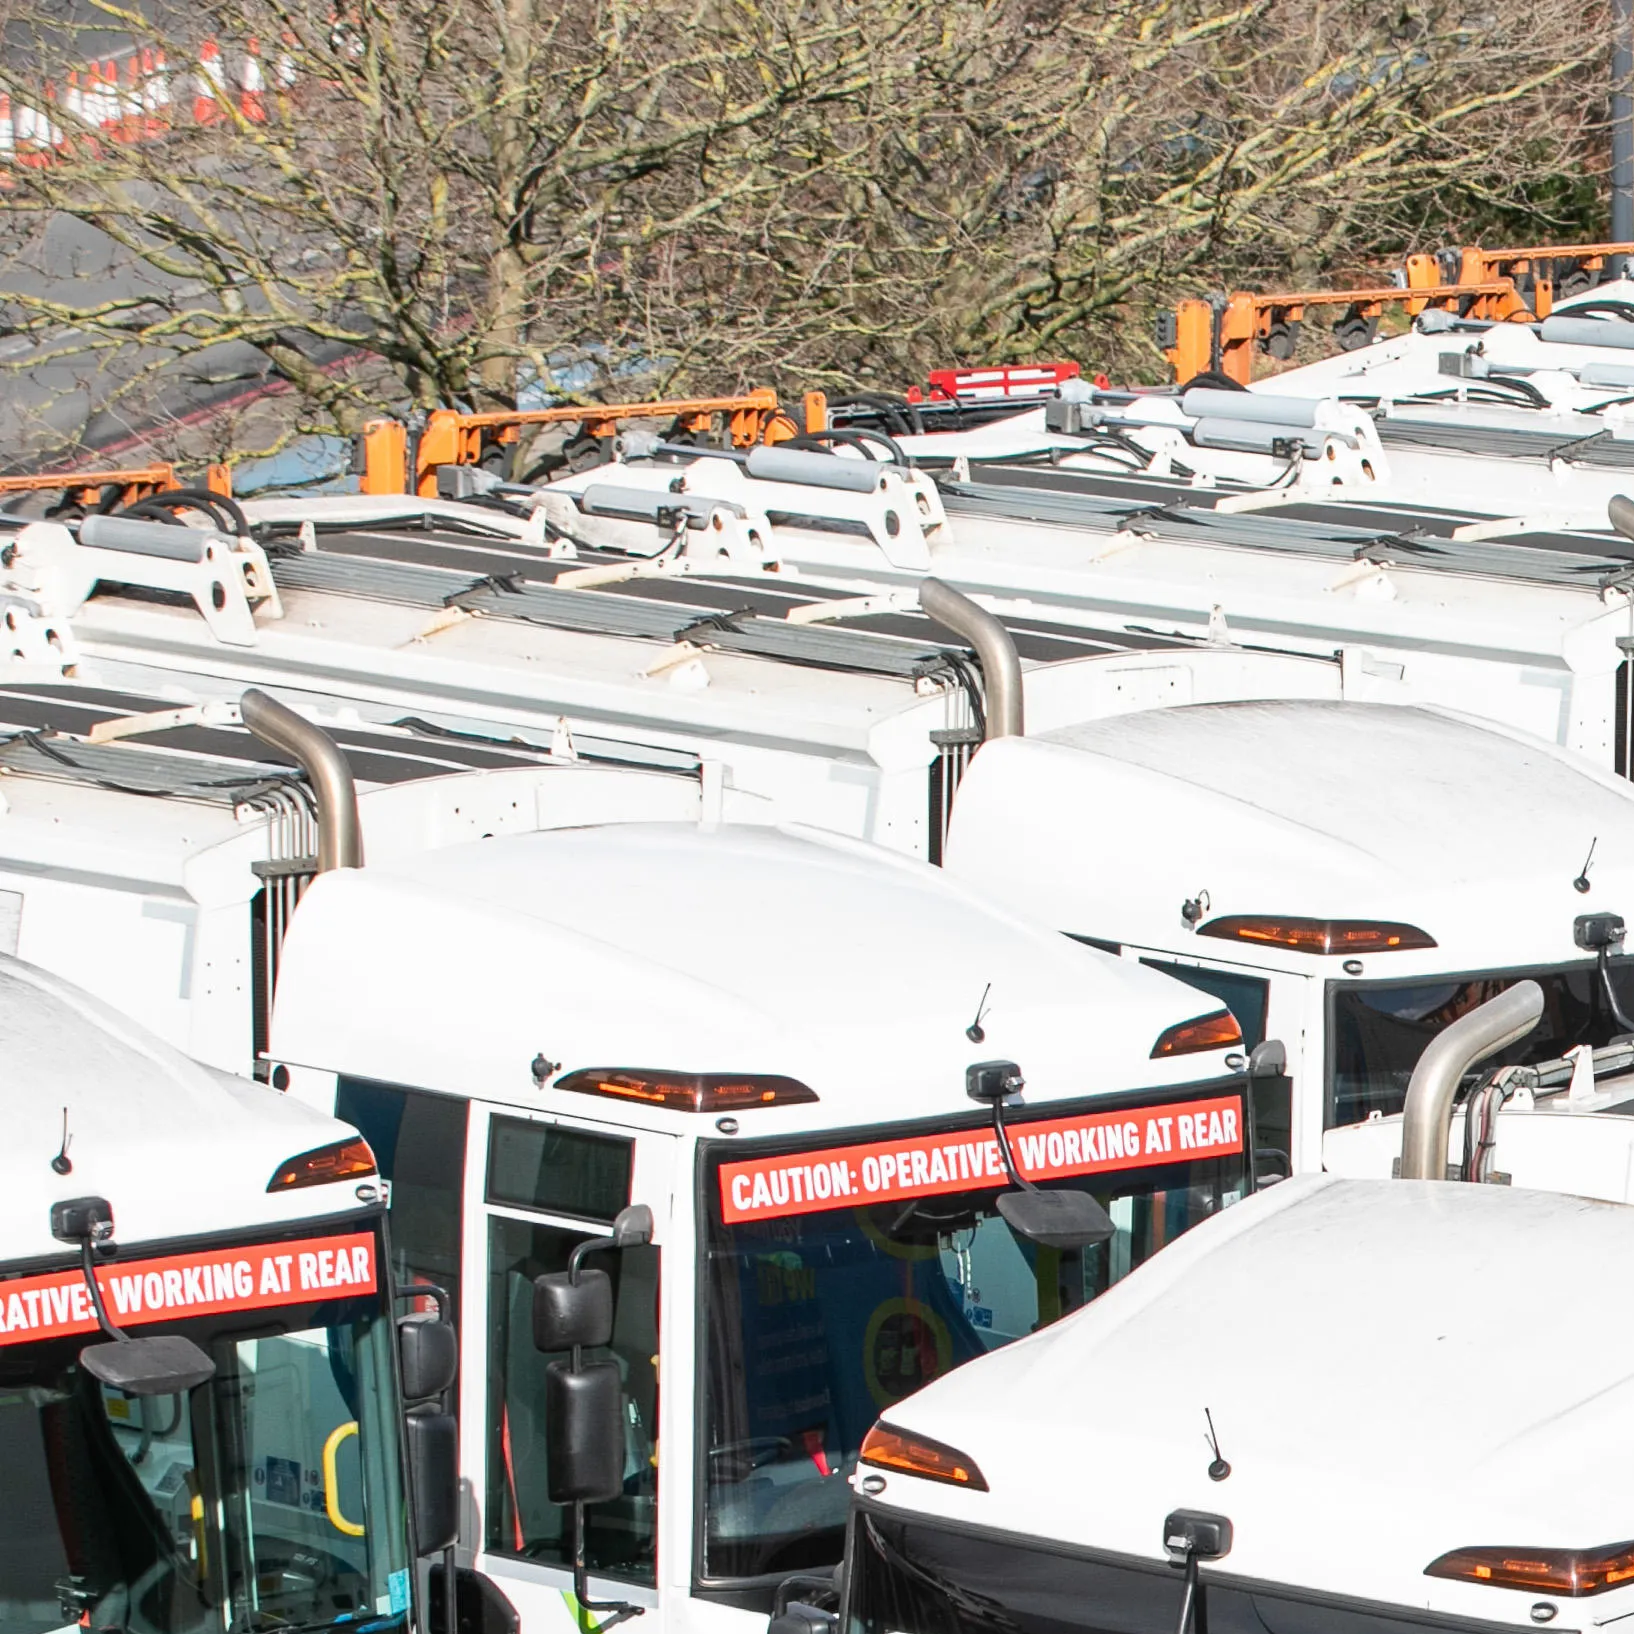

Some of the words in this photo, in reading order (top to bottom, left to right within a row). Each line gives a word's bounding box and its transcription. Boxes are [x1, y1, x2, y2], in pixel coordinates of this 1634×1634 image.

[731, 1160, 860, 1211] CAUTION:
[1020, 1120, 1140, 1171] WORKING
[1144, 1116, 1174, 1155] AT
[1178, 1108, 1239, 1147] REAR
[109, 1258, 253, 1315] WORKING
[259, 1253, 293, 1296] AT
[298, 1245, 372, 1292] REAR
